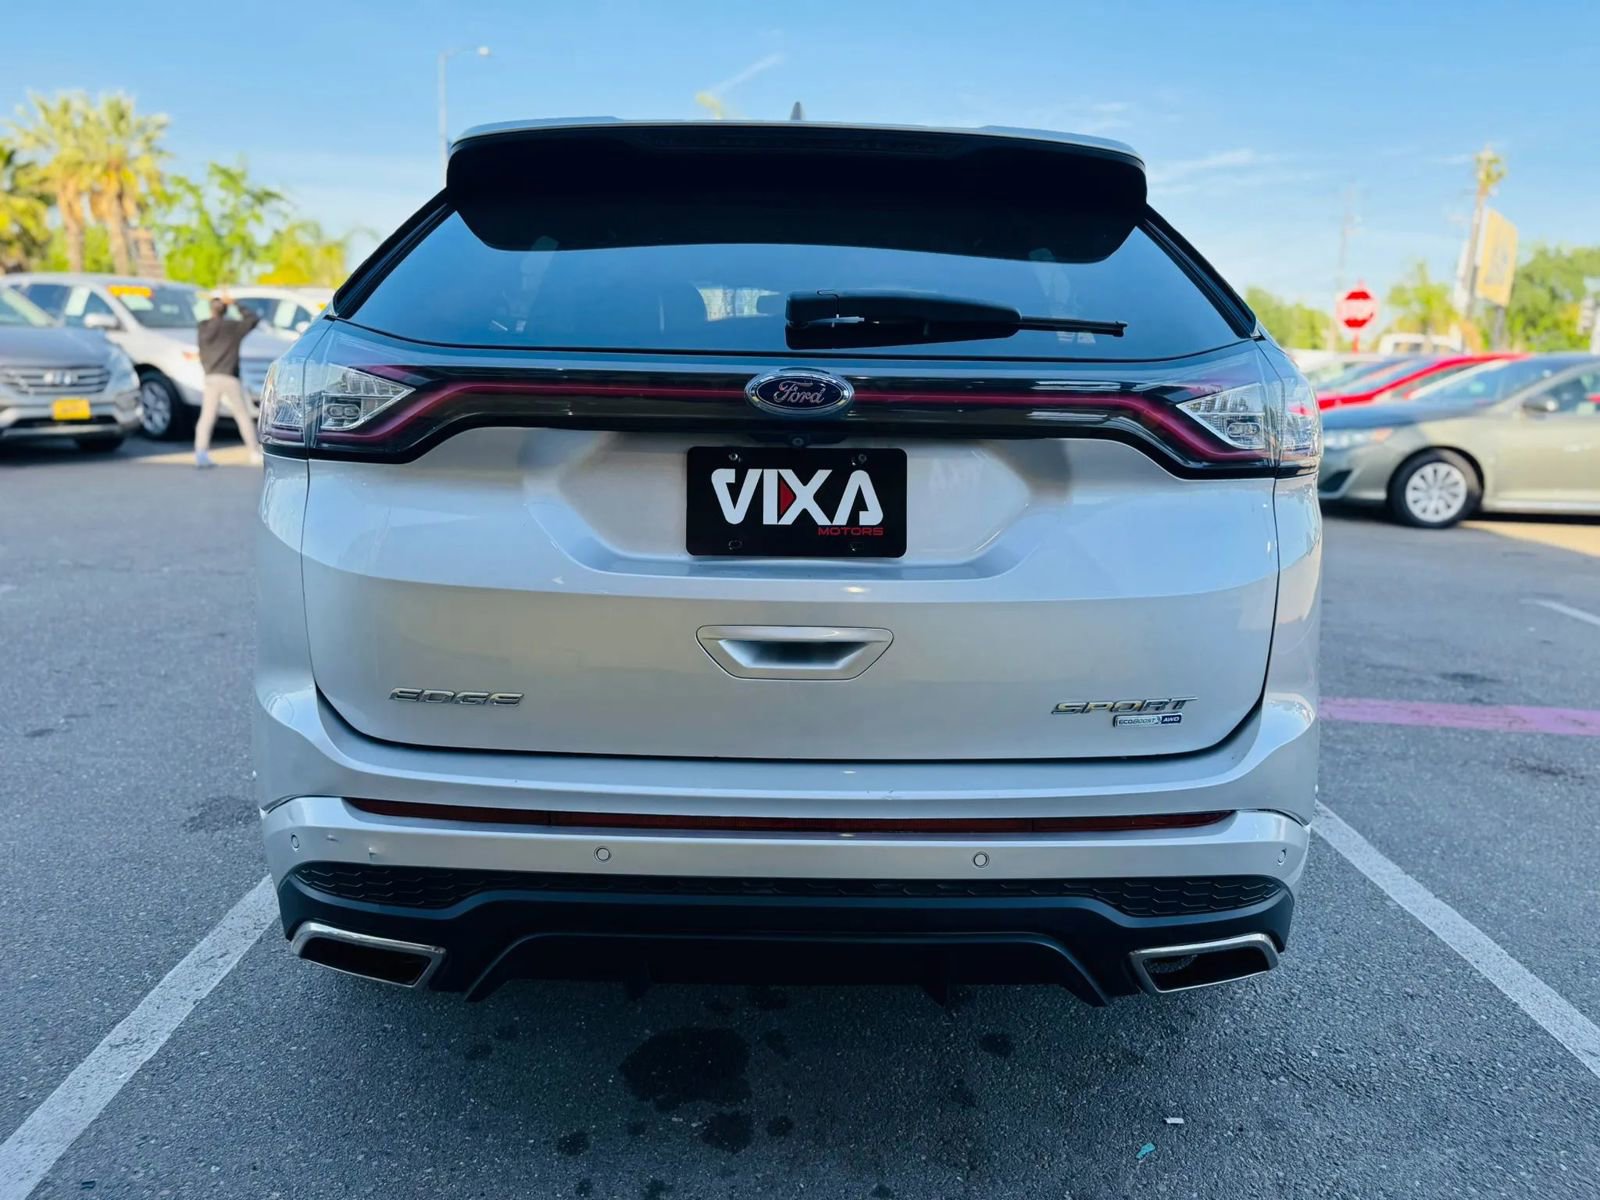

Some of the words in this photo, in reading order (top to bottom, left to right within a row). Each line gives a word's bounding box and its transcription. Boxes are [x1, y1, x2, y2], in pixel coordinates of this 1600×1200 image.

[773, 380, 827, 404] Ford
[711, 468, 884, 526] VIXA
[817, 526, 884, 536] MOTORS
[389, 687, 525, 707] EDGE
[1051, 696, 1199, 715] SPORT
